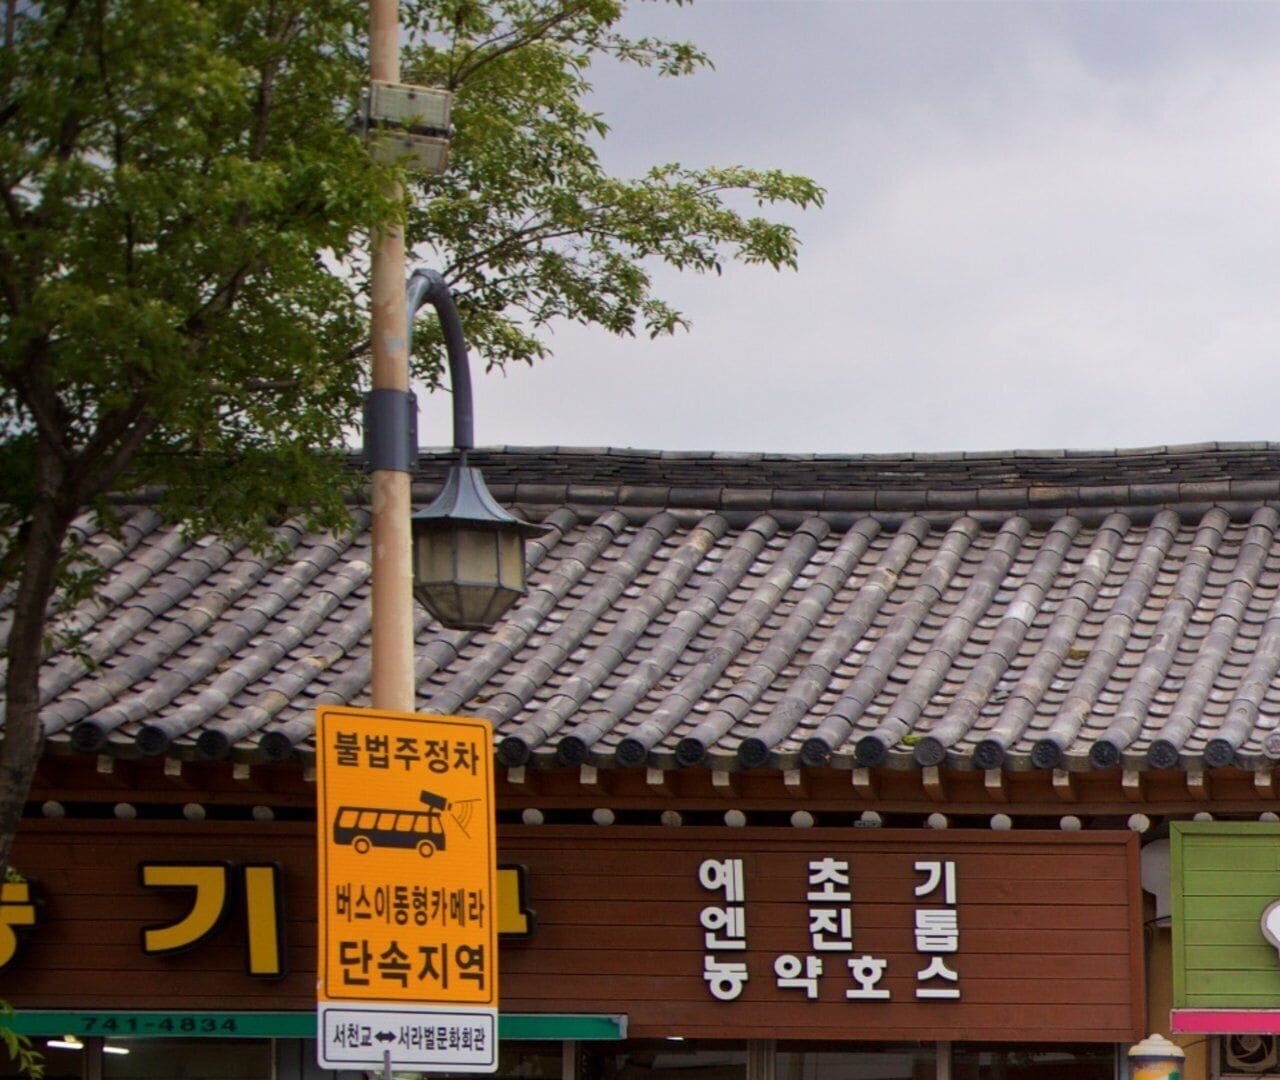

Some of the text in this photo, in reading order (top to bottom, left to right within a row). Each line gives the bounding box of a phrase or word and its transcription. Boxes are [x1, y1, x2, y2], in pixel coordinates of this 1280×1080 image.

[334, 731, 479, 776] 불법주정차
[339, 940, 484, 990] 단속지역
[81, 1018, 237, 1032] 741-4834
[333, 1023, 373, 1048] 서천교
